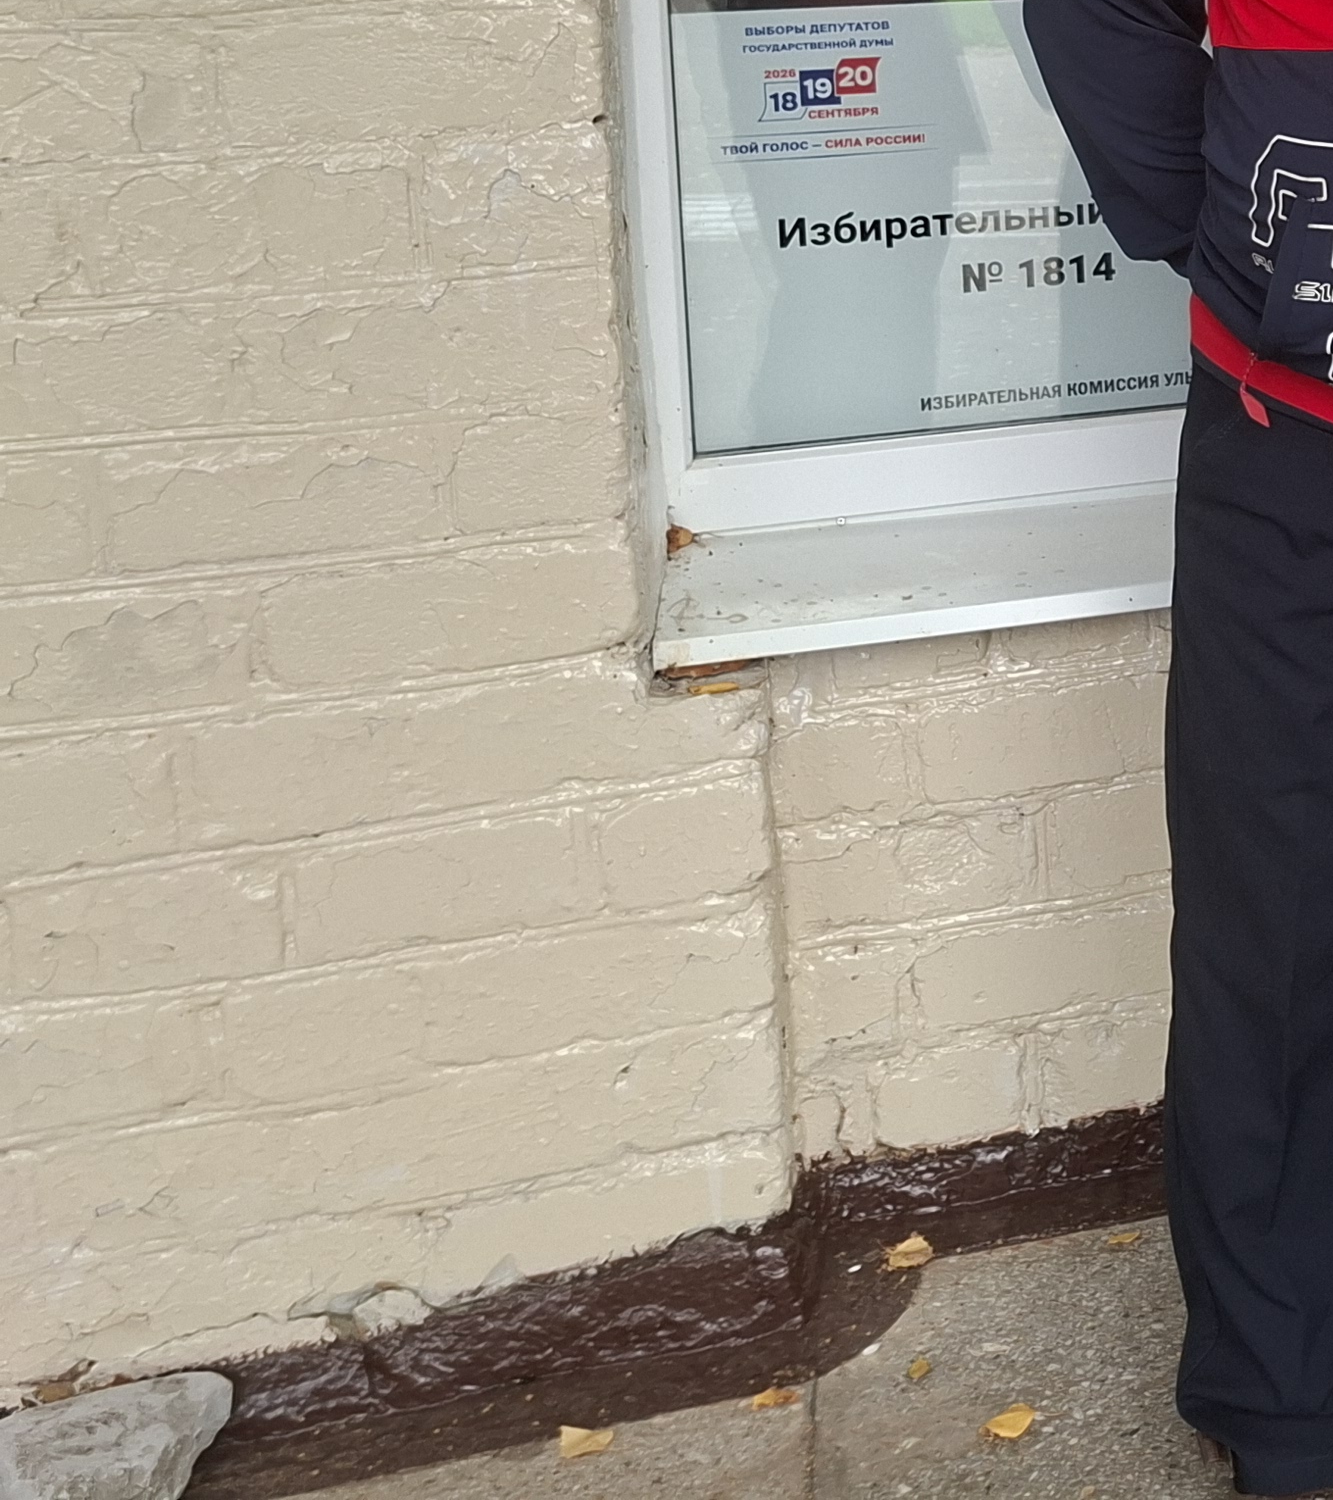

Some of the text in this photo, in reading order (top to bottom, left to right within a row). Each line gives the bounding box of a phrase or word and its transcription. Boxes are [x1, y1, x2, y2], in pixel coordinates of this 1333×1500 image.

[744, 20, 890, 37] ВЫБОРЫ ДЕПУТАТОВ
[742, 38, 894, 54] ГОСУДАРСТВЕННОЙ ДУМЫ
[764, 69, 796, 79] 2026
[769, 66, 873, 112] 18 19 20
[808, 107, 879, 120] СЕНТЯБРЯ
[721, 143, 759, 156] ТВОЙ
[762, 141, 808, 153] ГОЛОС
[824, 138, 863, 149] СИЛА
[866, 133, 926, 147] РОССИИ!
[962, 253, 1116, 293] № 1814
[920, 384, 1062, 411] ИЗБИРАТЕЛЬНАЯ
[1067, 374, 1160, 398] КОМИССИЯ
